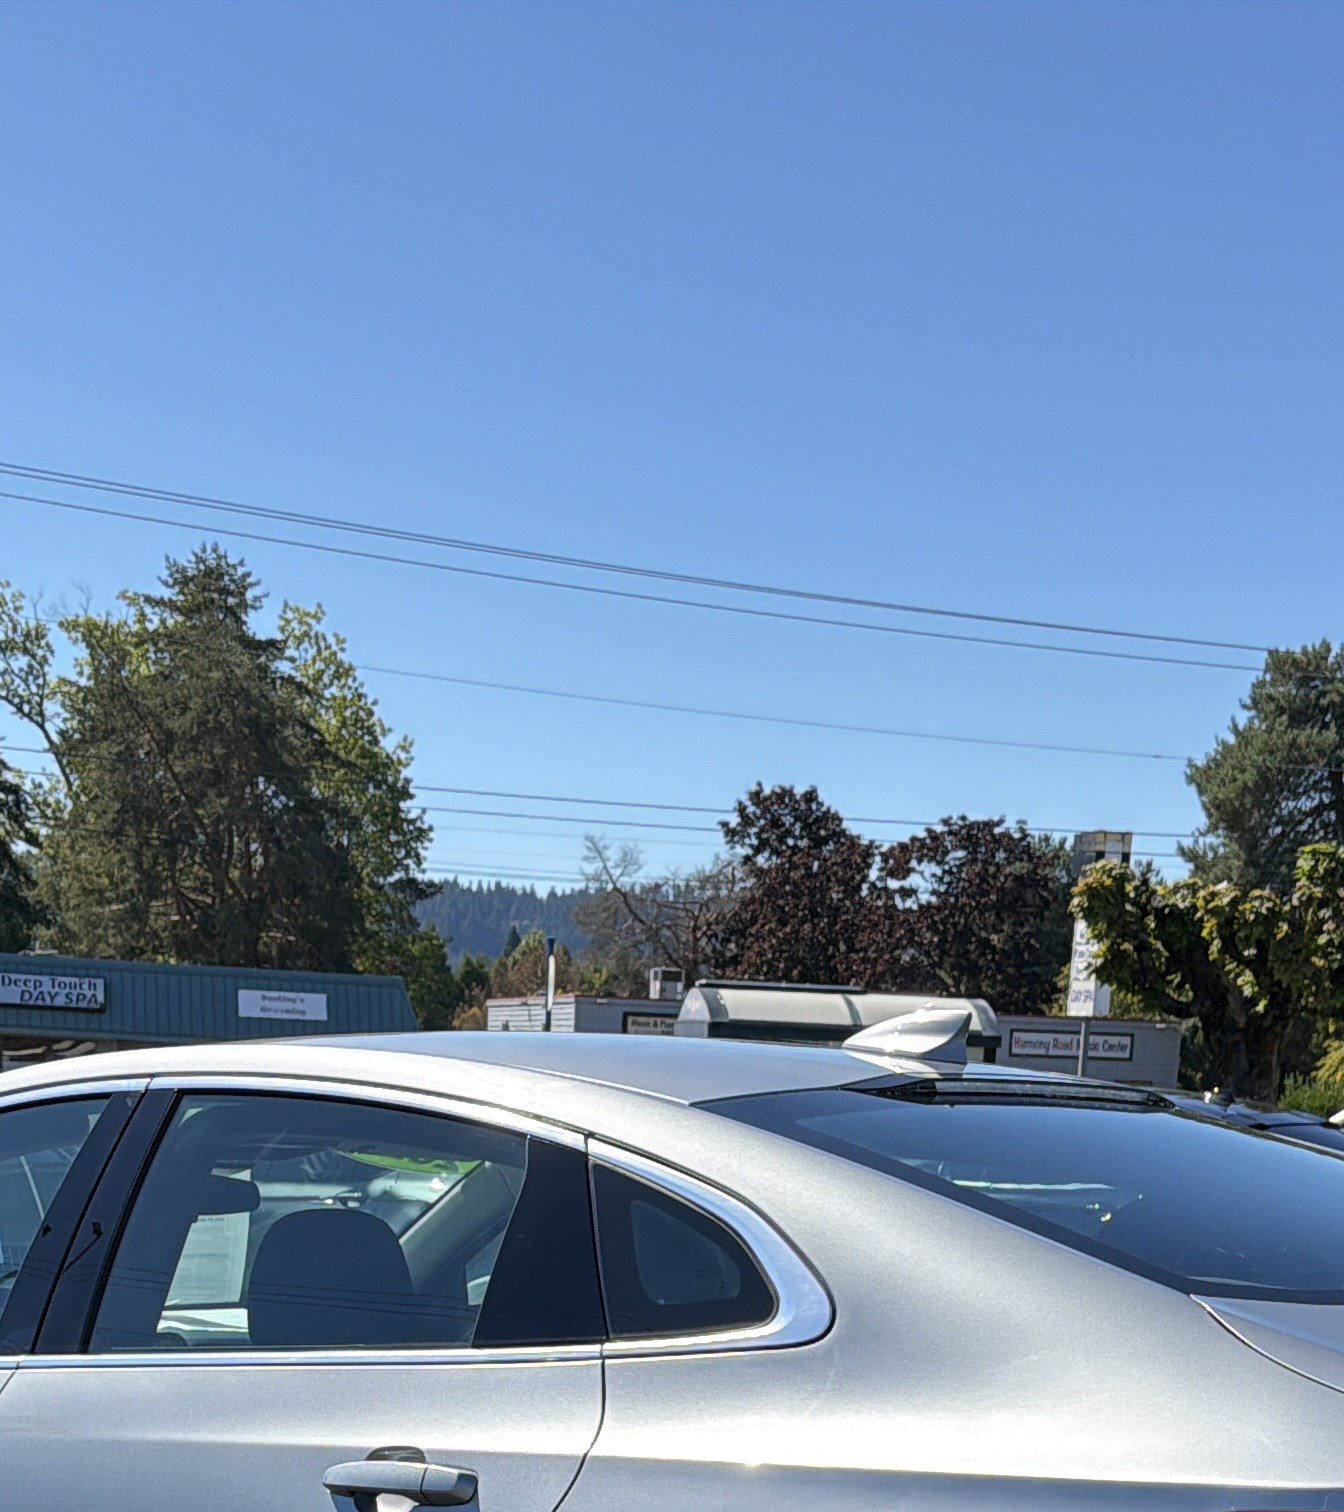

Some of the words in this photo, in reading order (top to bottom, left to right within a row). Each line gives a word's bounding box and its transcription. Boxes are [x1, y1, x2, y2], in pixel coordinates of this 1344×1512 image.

[1, 974, 43, 991] Deep
[50, 978, 97, 992] Touch
[20, 989, 59, 1004] DAY
[63, 991, 99, 1007] SPA
[1014, 1037, 1051, 1054] Harmony
[1052, 1037, 1074, 1051] Road
[1101, 1039, 1129, 1053] Center
